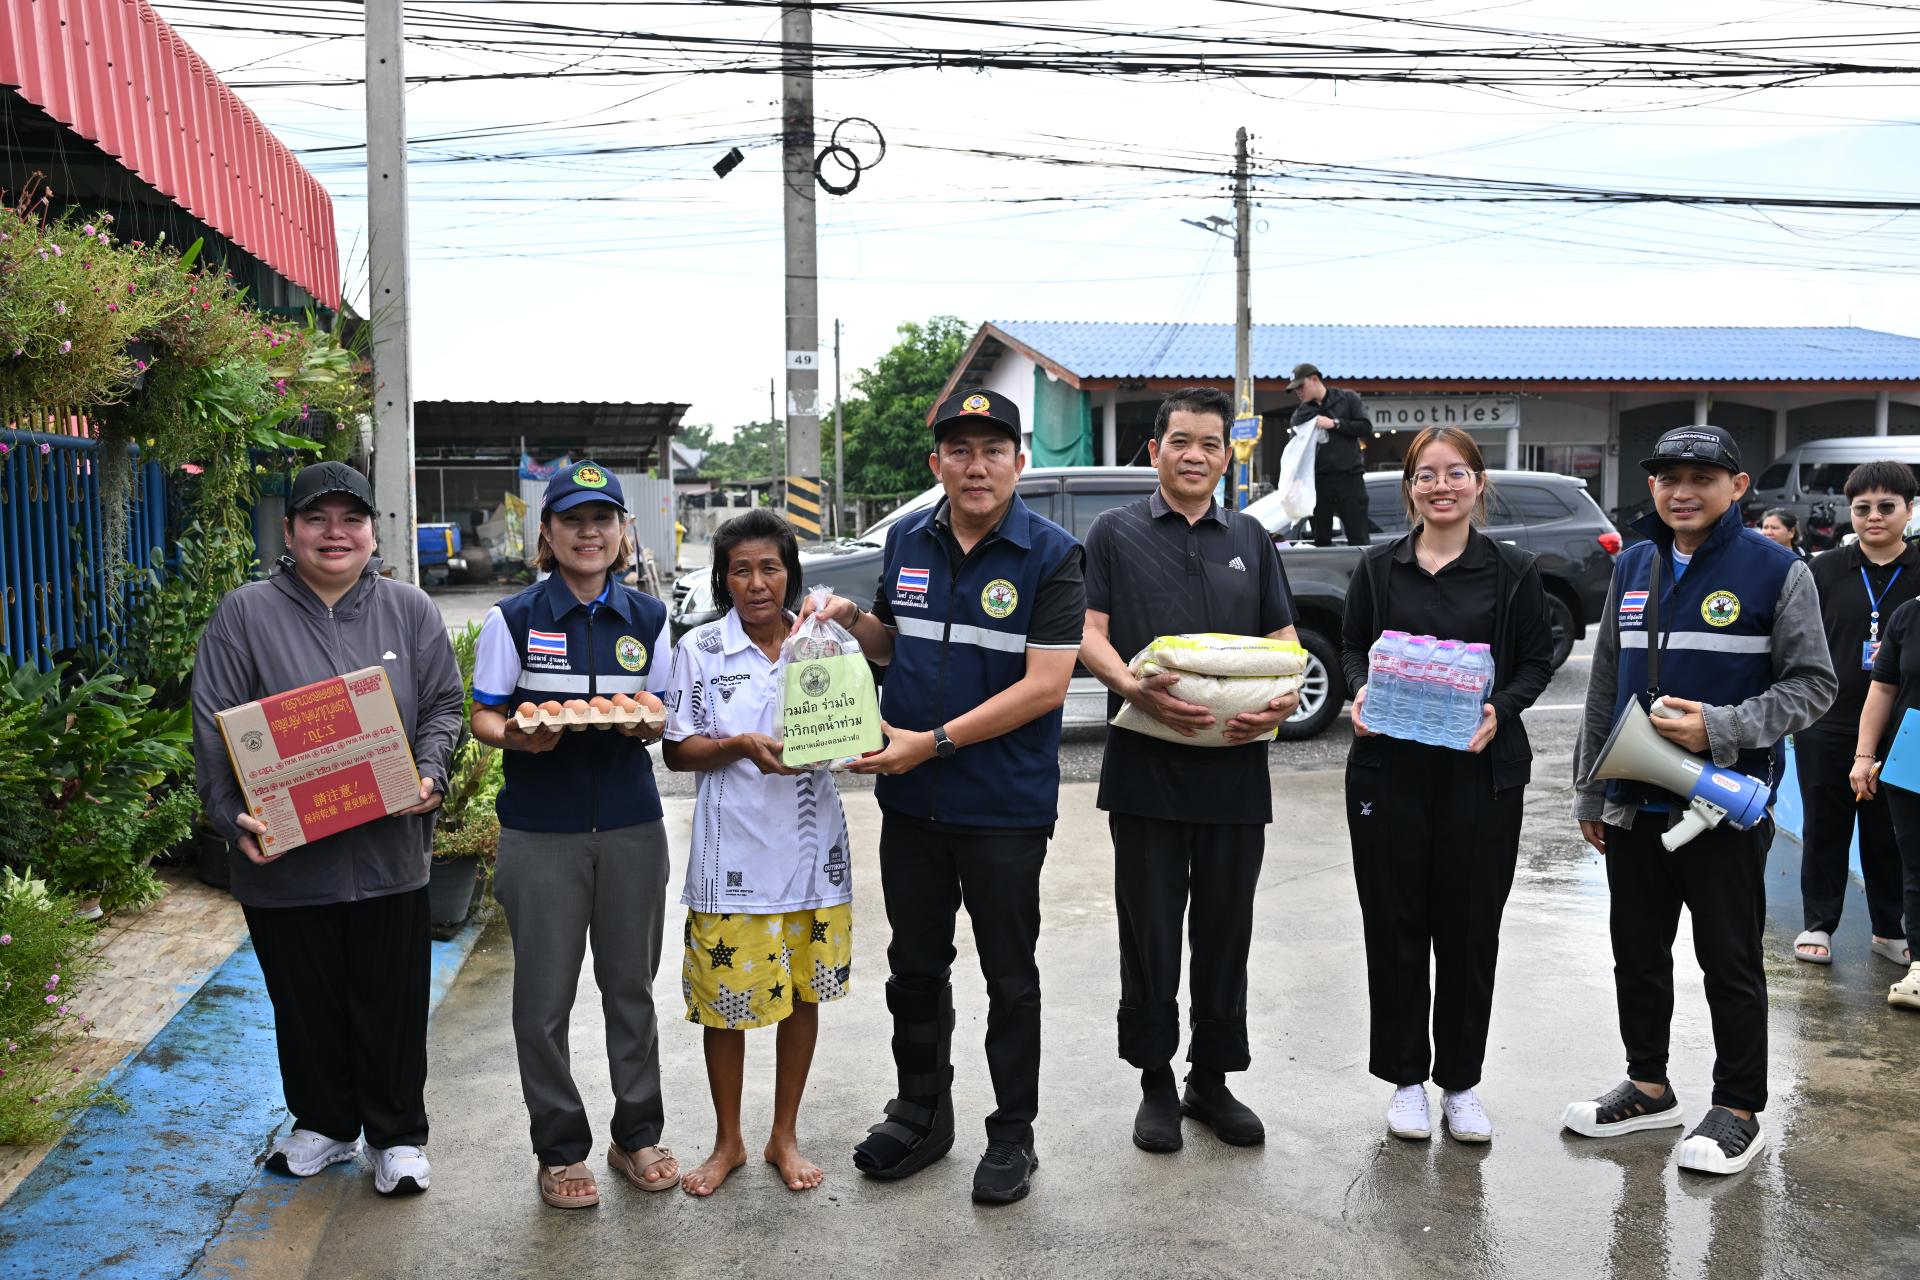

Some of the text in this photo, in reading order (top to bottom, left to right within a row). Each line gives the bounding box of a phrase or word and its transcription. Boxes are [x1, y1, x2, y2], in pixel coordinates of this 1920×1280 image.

[794, 355, 811, 365] 49
[1365, 404, 1501, 424] moothies
[822, 692, 855, 710] ร่วมใจ
[346, 737, 358, 745] WAI
[359, 733, 371, 741] WAI
[284, 757, 297, 766] WAI
[298, 753, 311, 761] WAI
[278, 780, 292, 789] WAI
[293, 775, 306, 784] WAI
[340, 759, 353, 768] WAI
[354, 754, 367, 762] WAI
